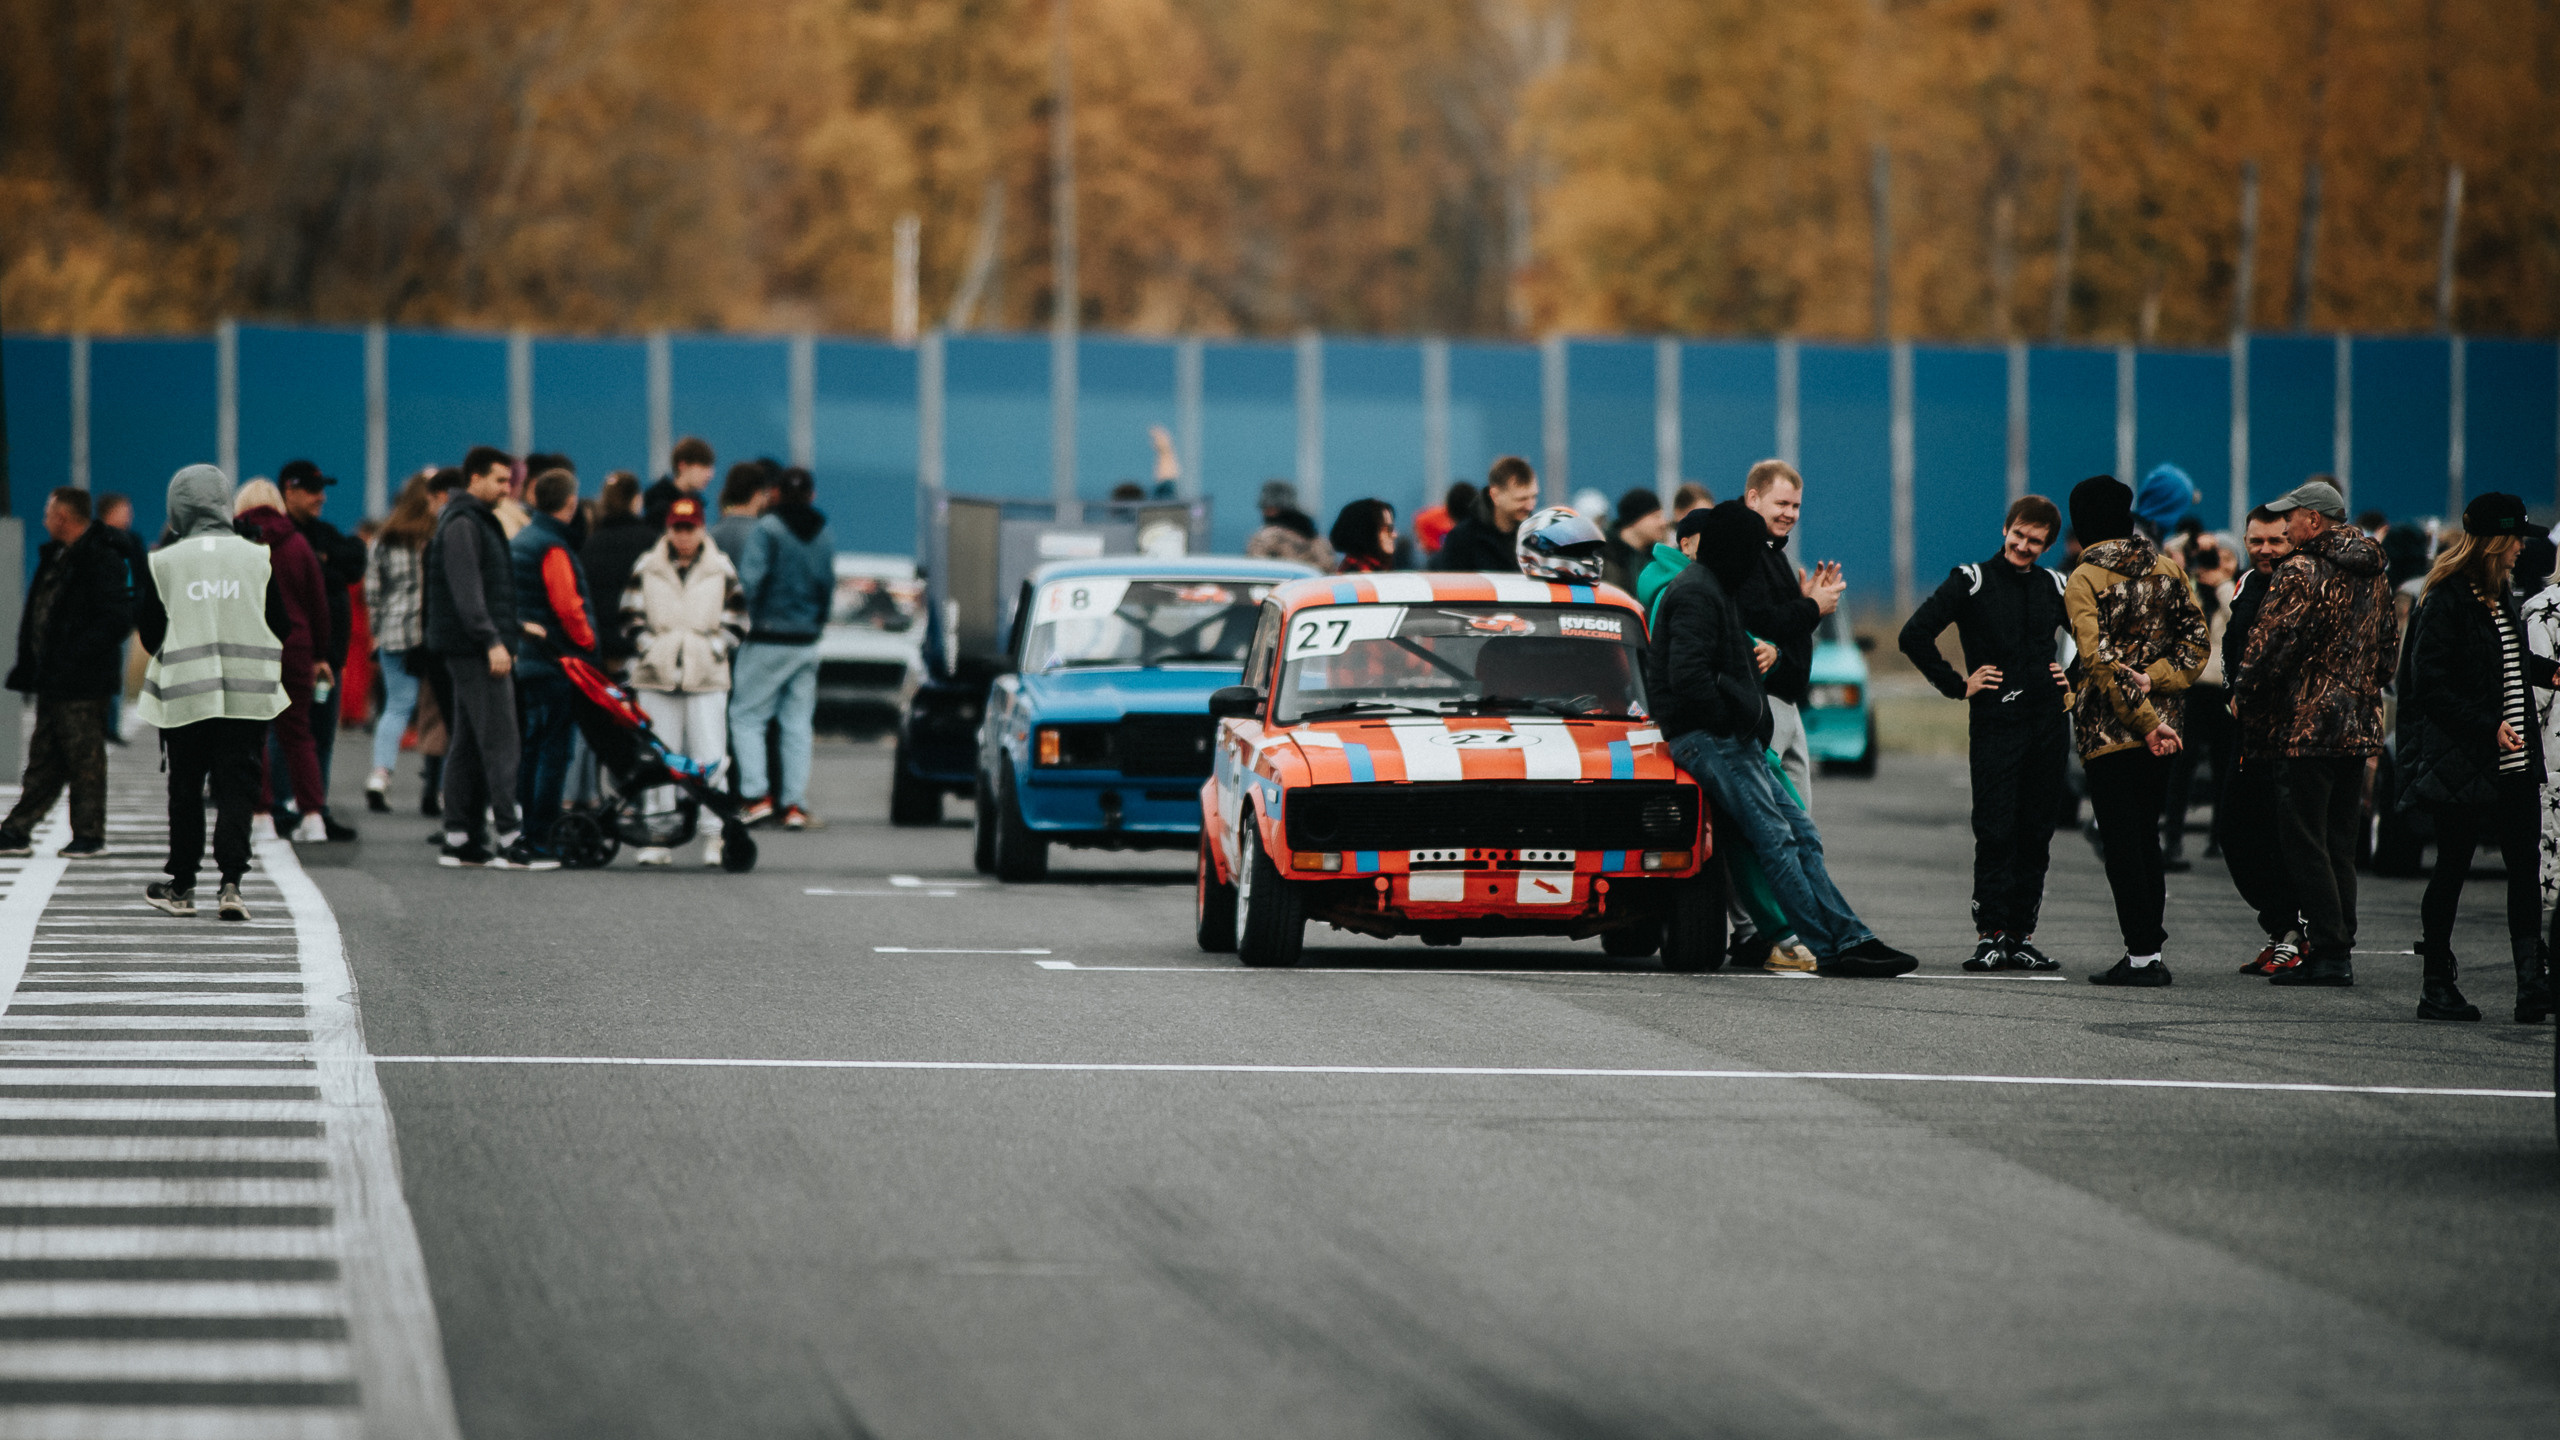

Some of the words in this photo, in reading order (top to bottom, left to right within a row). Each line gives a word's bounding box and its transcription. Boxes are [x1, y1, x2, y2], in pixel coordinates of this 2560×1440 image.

[187, 579, 240, 601] СМИ
[1558, 615, 1622, 633] КУБОК
[1297, 620, 1350, 651] 27
[1561, 629, 1622, 640] КЛАССИКИ
[1449, 733, 1518, 745] 27
